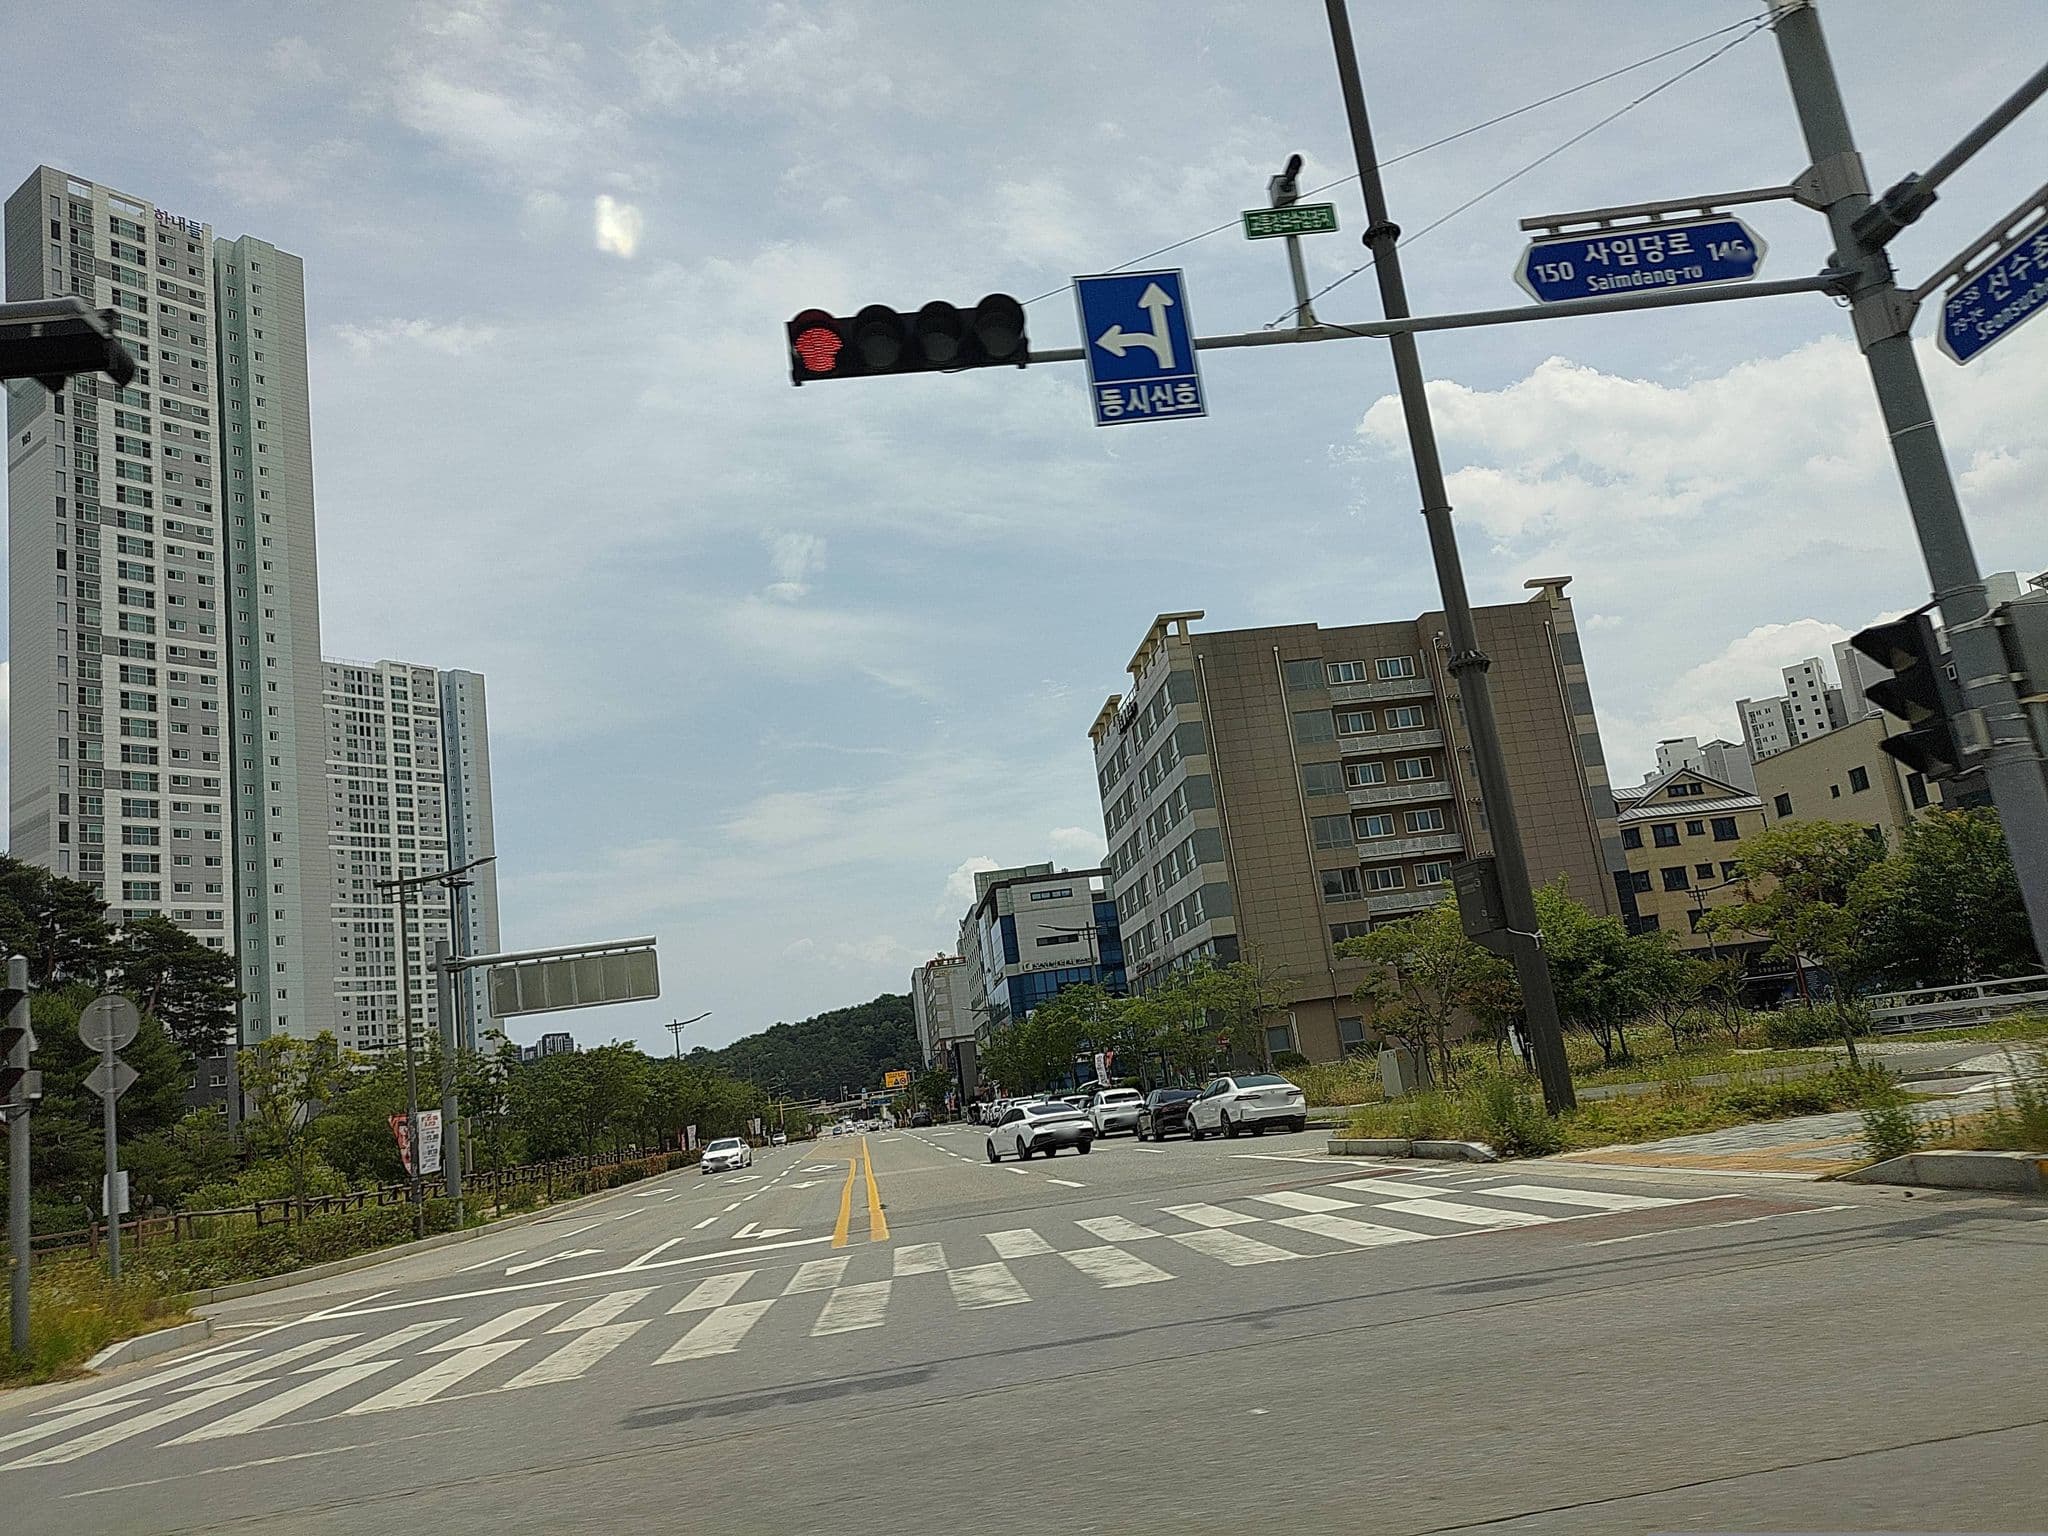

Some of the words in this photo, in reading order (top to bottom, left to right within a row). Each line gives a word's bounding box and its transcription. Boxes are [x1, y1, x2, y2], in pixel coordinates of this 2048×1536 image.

[154, 208, 204, 240] 한내들
[1533, 261, 1575, 284] 150
[1584, 232, 1695, 265] 사임당로
[1586, 264, 1703, 293] Saimdang-ro
[1099, 383, 1201, 418] 동시신호
